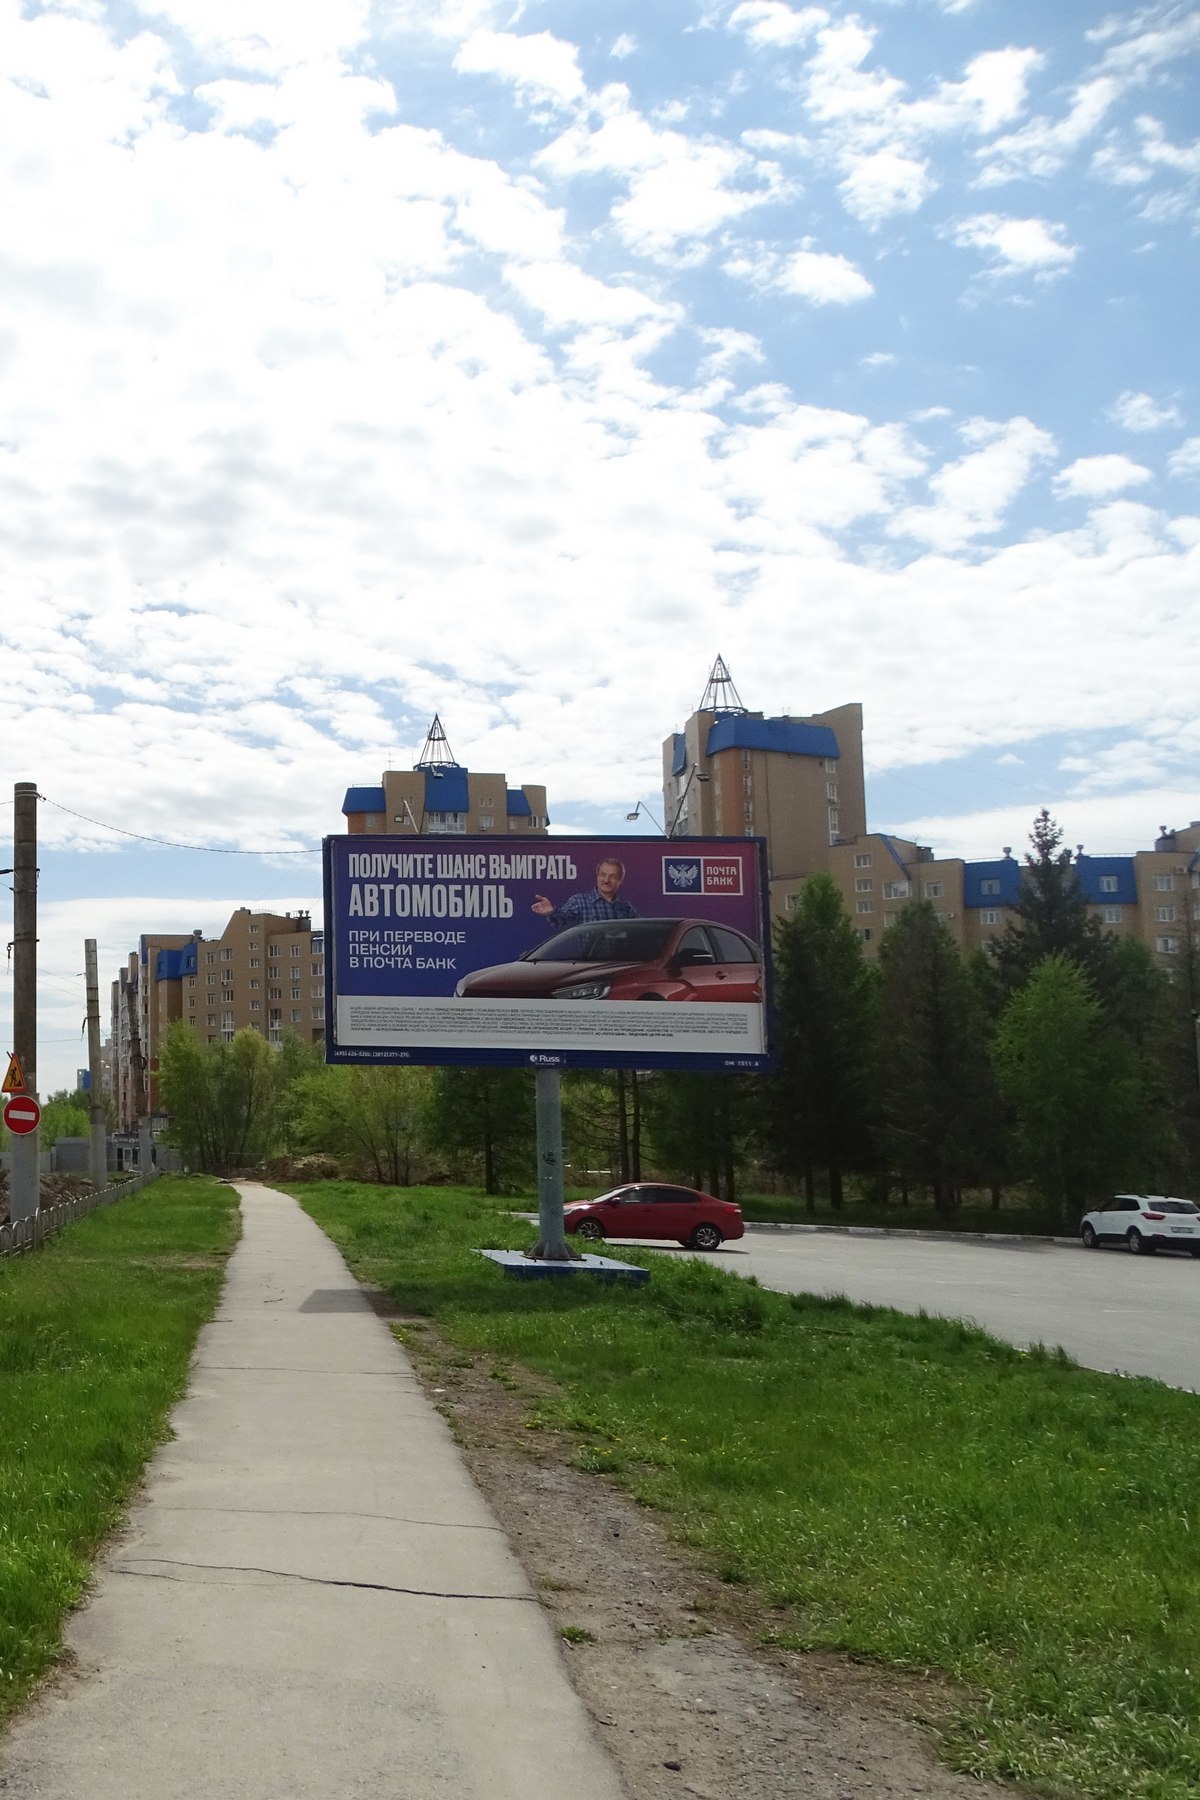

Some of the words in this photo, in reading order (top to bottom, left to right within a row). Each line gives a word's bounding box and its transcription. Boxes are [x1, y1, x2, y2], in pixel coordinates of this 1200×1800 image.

[348, 853, 434, 878] ПОЛУЧИТЕ
[436, 854, 486, 880] ШАНС
[489, 854, 578, 880] ВЫИГРАТЬ
[706, 866, 737, 876] ПОЧТА
[706, 876, 734, 886] БАНК
[348, 883, 514, 919] АВТОМОБИЛЬ
[349, 930, 380, 942] ПРИ
[384, 930, 467, 945] ПЕРЕВОДЕ
[349, 943, 413, 956] ПЕНСИИ
[349, 956, 359, 968] В
[363, 956, 413, 969] ПОЧТА
[416, 957, 457, 970] БАНК
[539, 1054, 560, 1063] Russ
